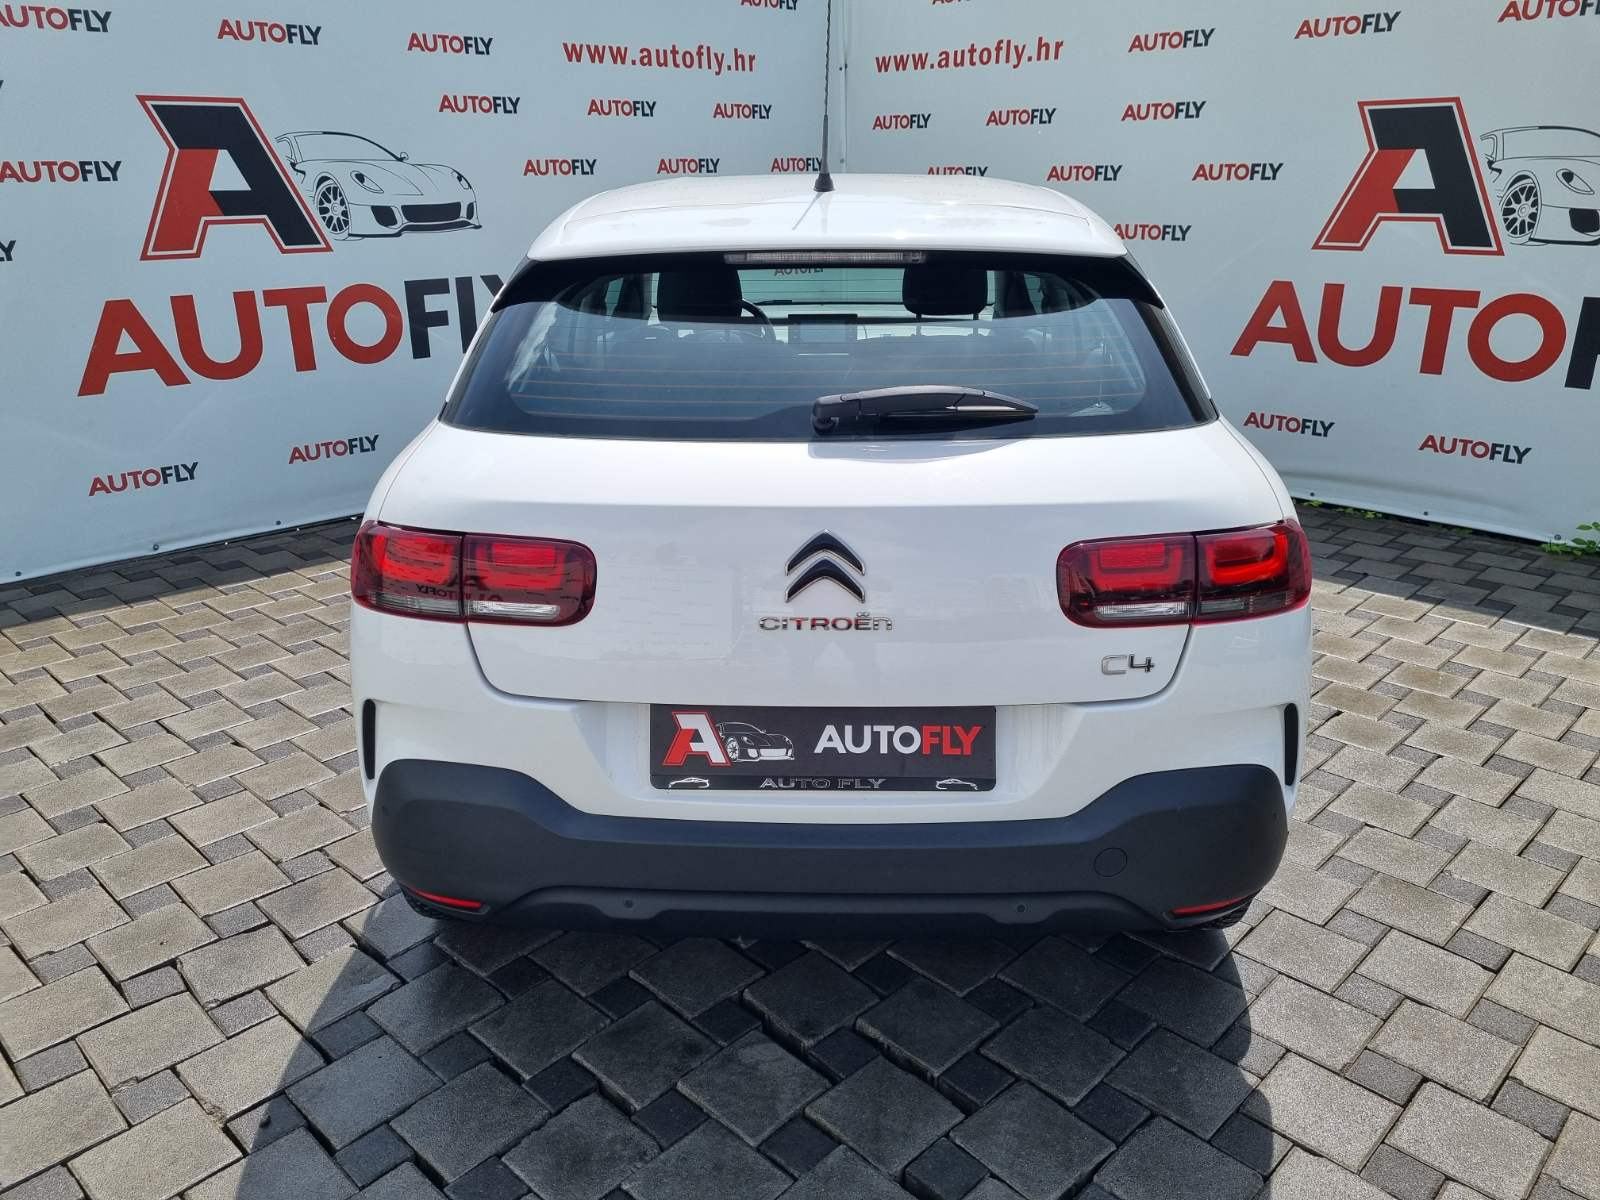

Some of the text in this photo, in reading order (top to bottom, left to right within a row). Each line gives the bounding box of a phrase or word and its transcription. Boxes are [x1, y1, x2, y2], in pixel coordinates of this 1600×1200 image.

[217, 19, 322, 46] AUTOFLY
[1295, 11, 1401, 39] AUTOFLY
[408, 32, 493, 56] AUTOFLY
[1129, 28, 1215, 53] AUTOFLY
[562, 41, 756, 76] www.autofly.hr
[875, 36, 1064, 73] www.autofly.hr
[439, 94, 520, 115] AUTOFLY
[588, 99, 657, 118] AUTOFLY
[713, 103, 772, 120] AUTOFLY
[1121, 101, 1206, 121] AUTOFLY
[873, 113, 931, 131] AUTOFLY
[986, 108, 1056, 127] AUTOFLY
[0, 160, 122, 183] AUTOFLY
[523, 158, 597, 177] AUTOFLY
[657, 158, 720, 175] AUTOFLY
[1047, 164, 1122, 182] AUTOFLY
[1192, 162, 1284, 181] AUTOFLY
[1113, 223, 1192, 241] AUTOFLY
[77, 274, 505, 397] AUTOFL
[1243, 411, 1335, 438] AUTOFLY
[289, 434, 379, 465] AUTOFLY
[1417, 434, 1532, 465] AUTOFLY
[88, 462, 198, 497] AUTOFLY
[1101, 653, 1155, 675] C4
[813, 724, 983, 756] AUTOFLY
[760, 777, 886, 789] AUTO FLY
